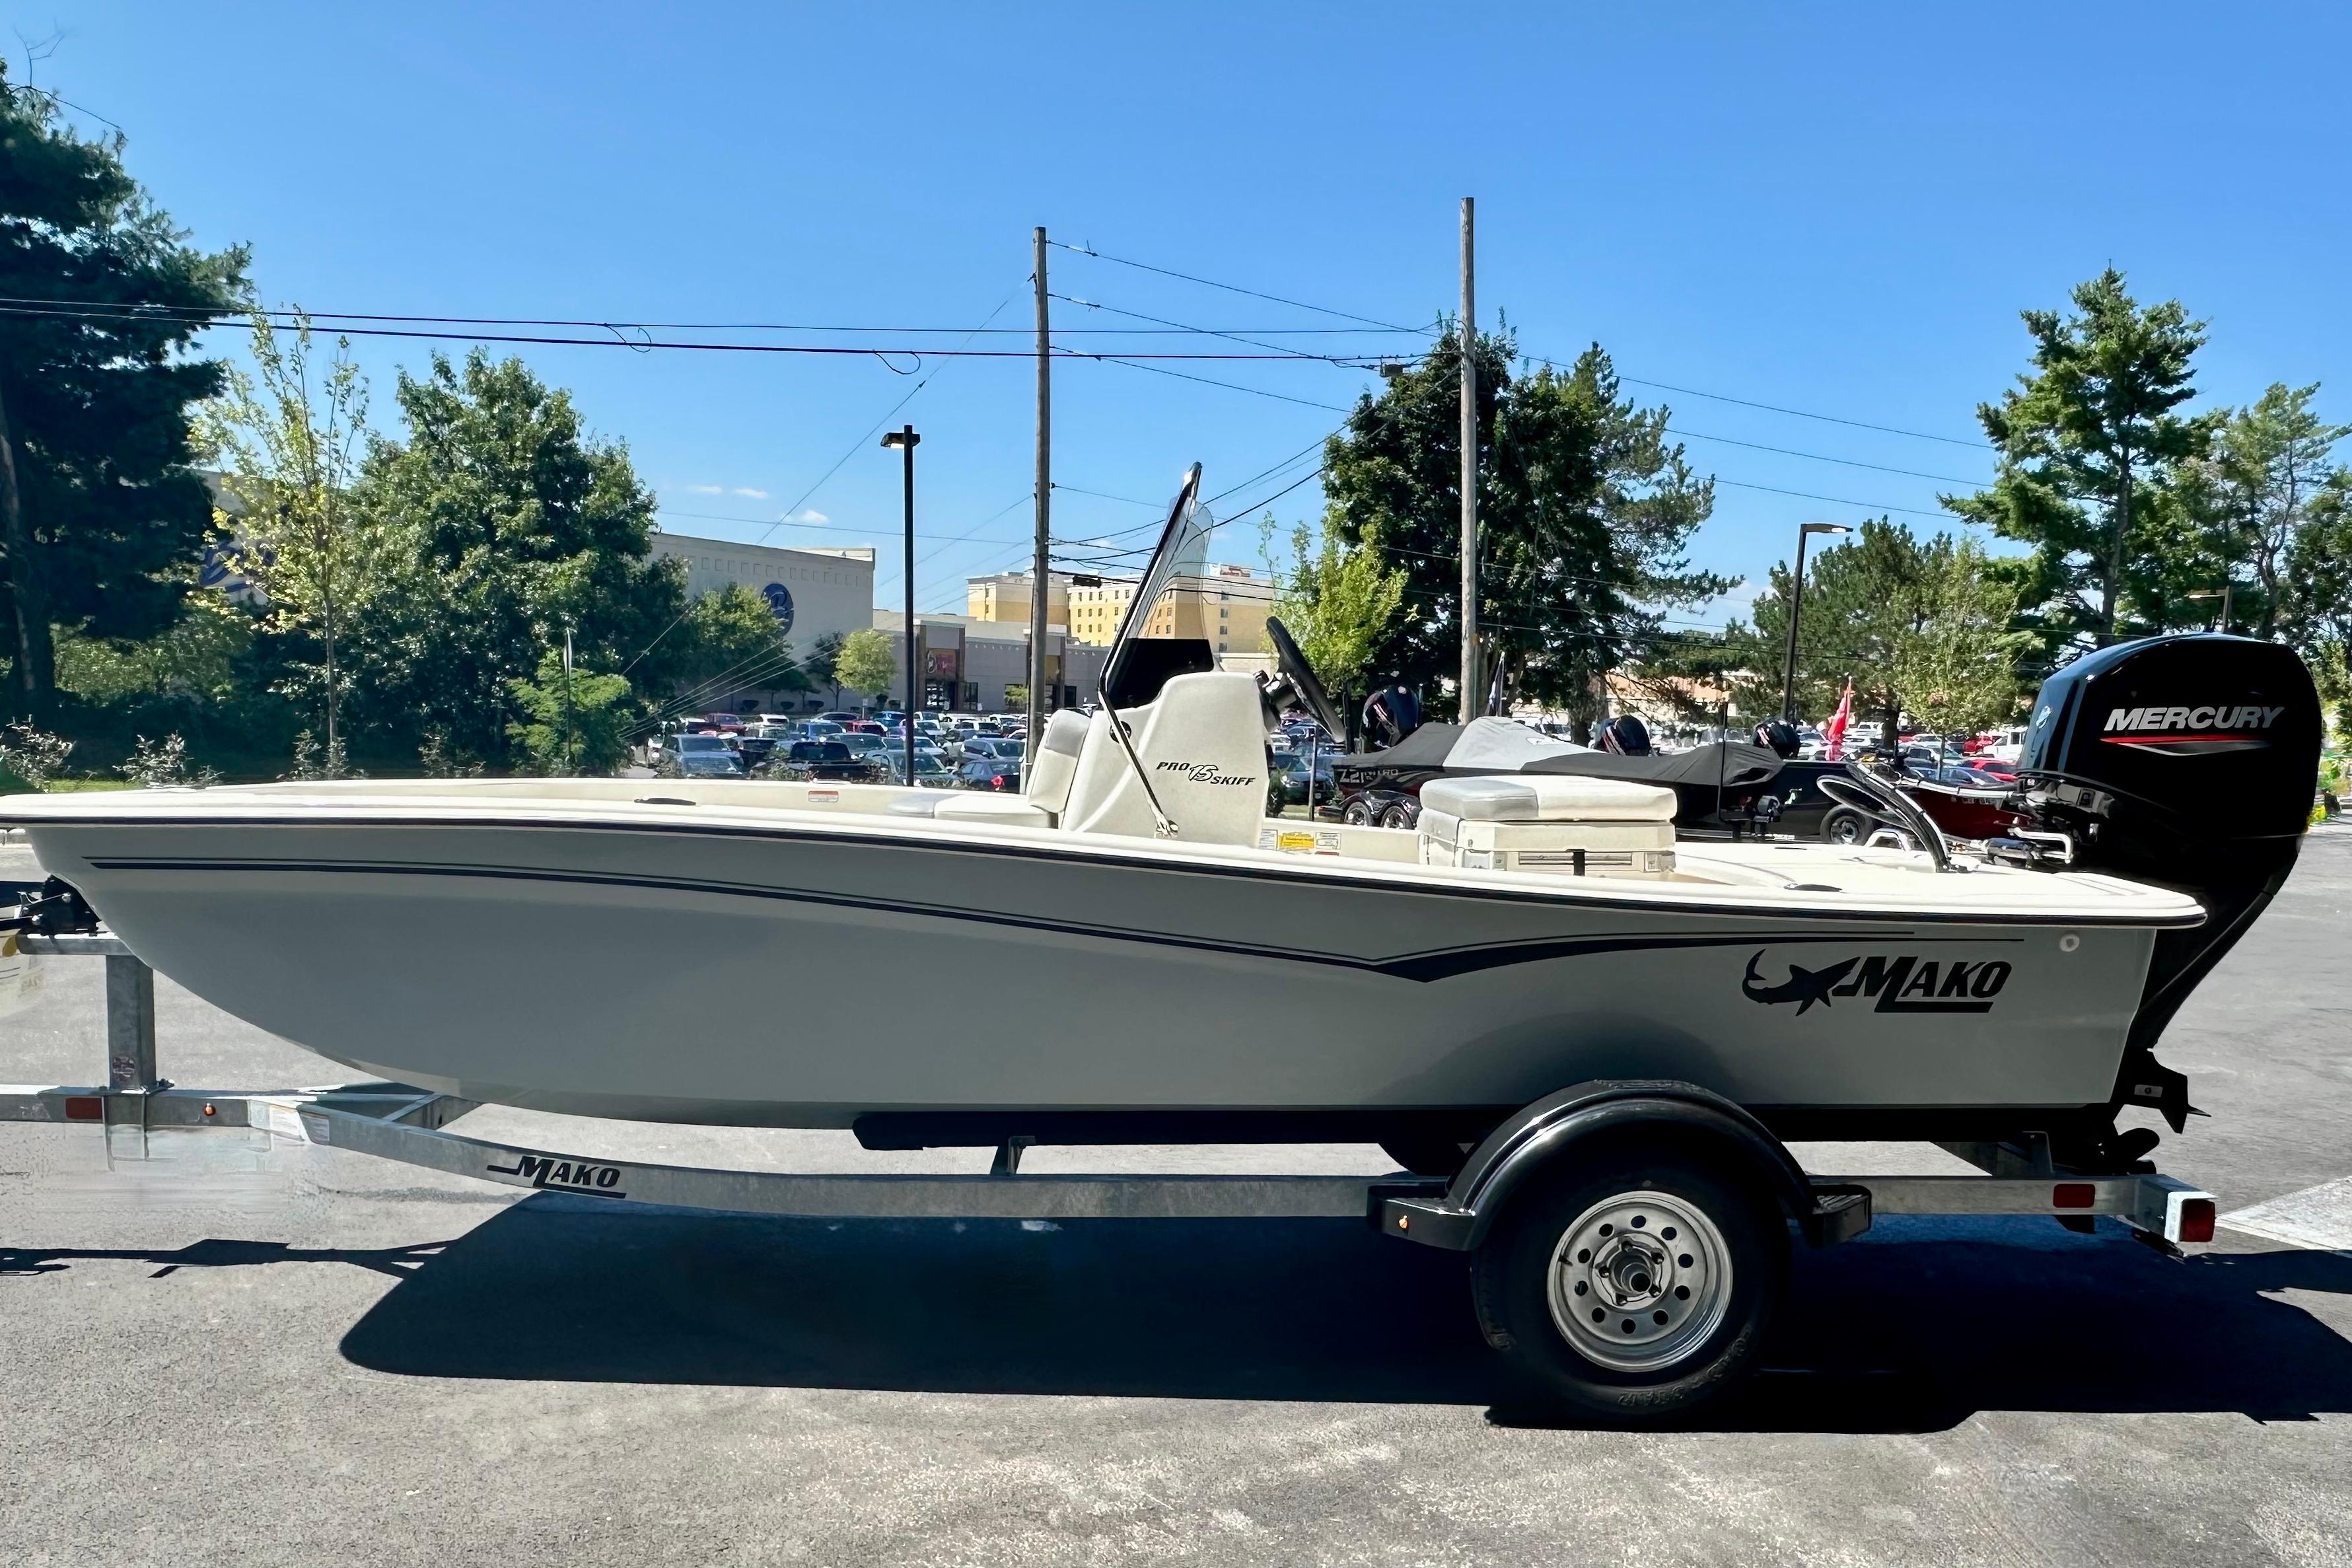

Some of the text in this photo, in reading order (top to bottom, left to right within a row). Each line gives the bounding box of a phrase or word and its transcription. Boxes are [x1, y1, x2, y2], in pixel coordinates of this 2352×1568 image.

[2103, 706, 2285, 731] MERCURY
[1156, 762, 1256, 786] PRO 15 SKIFF
[1832, 956, 2013, 1013] MAKO
[486, 1155, 627, 1199] MAKO
